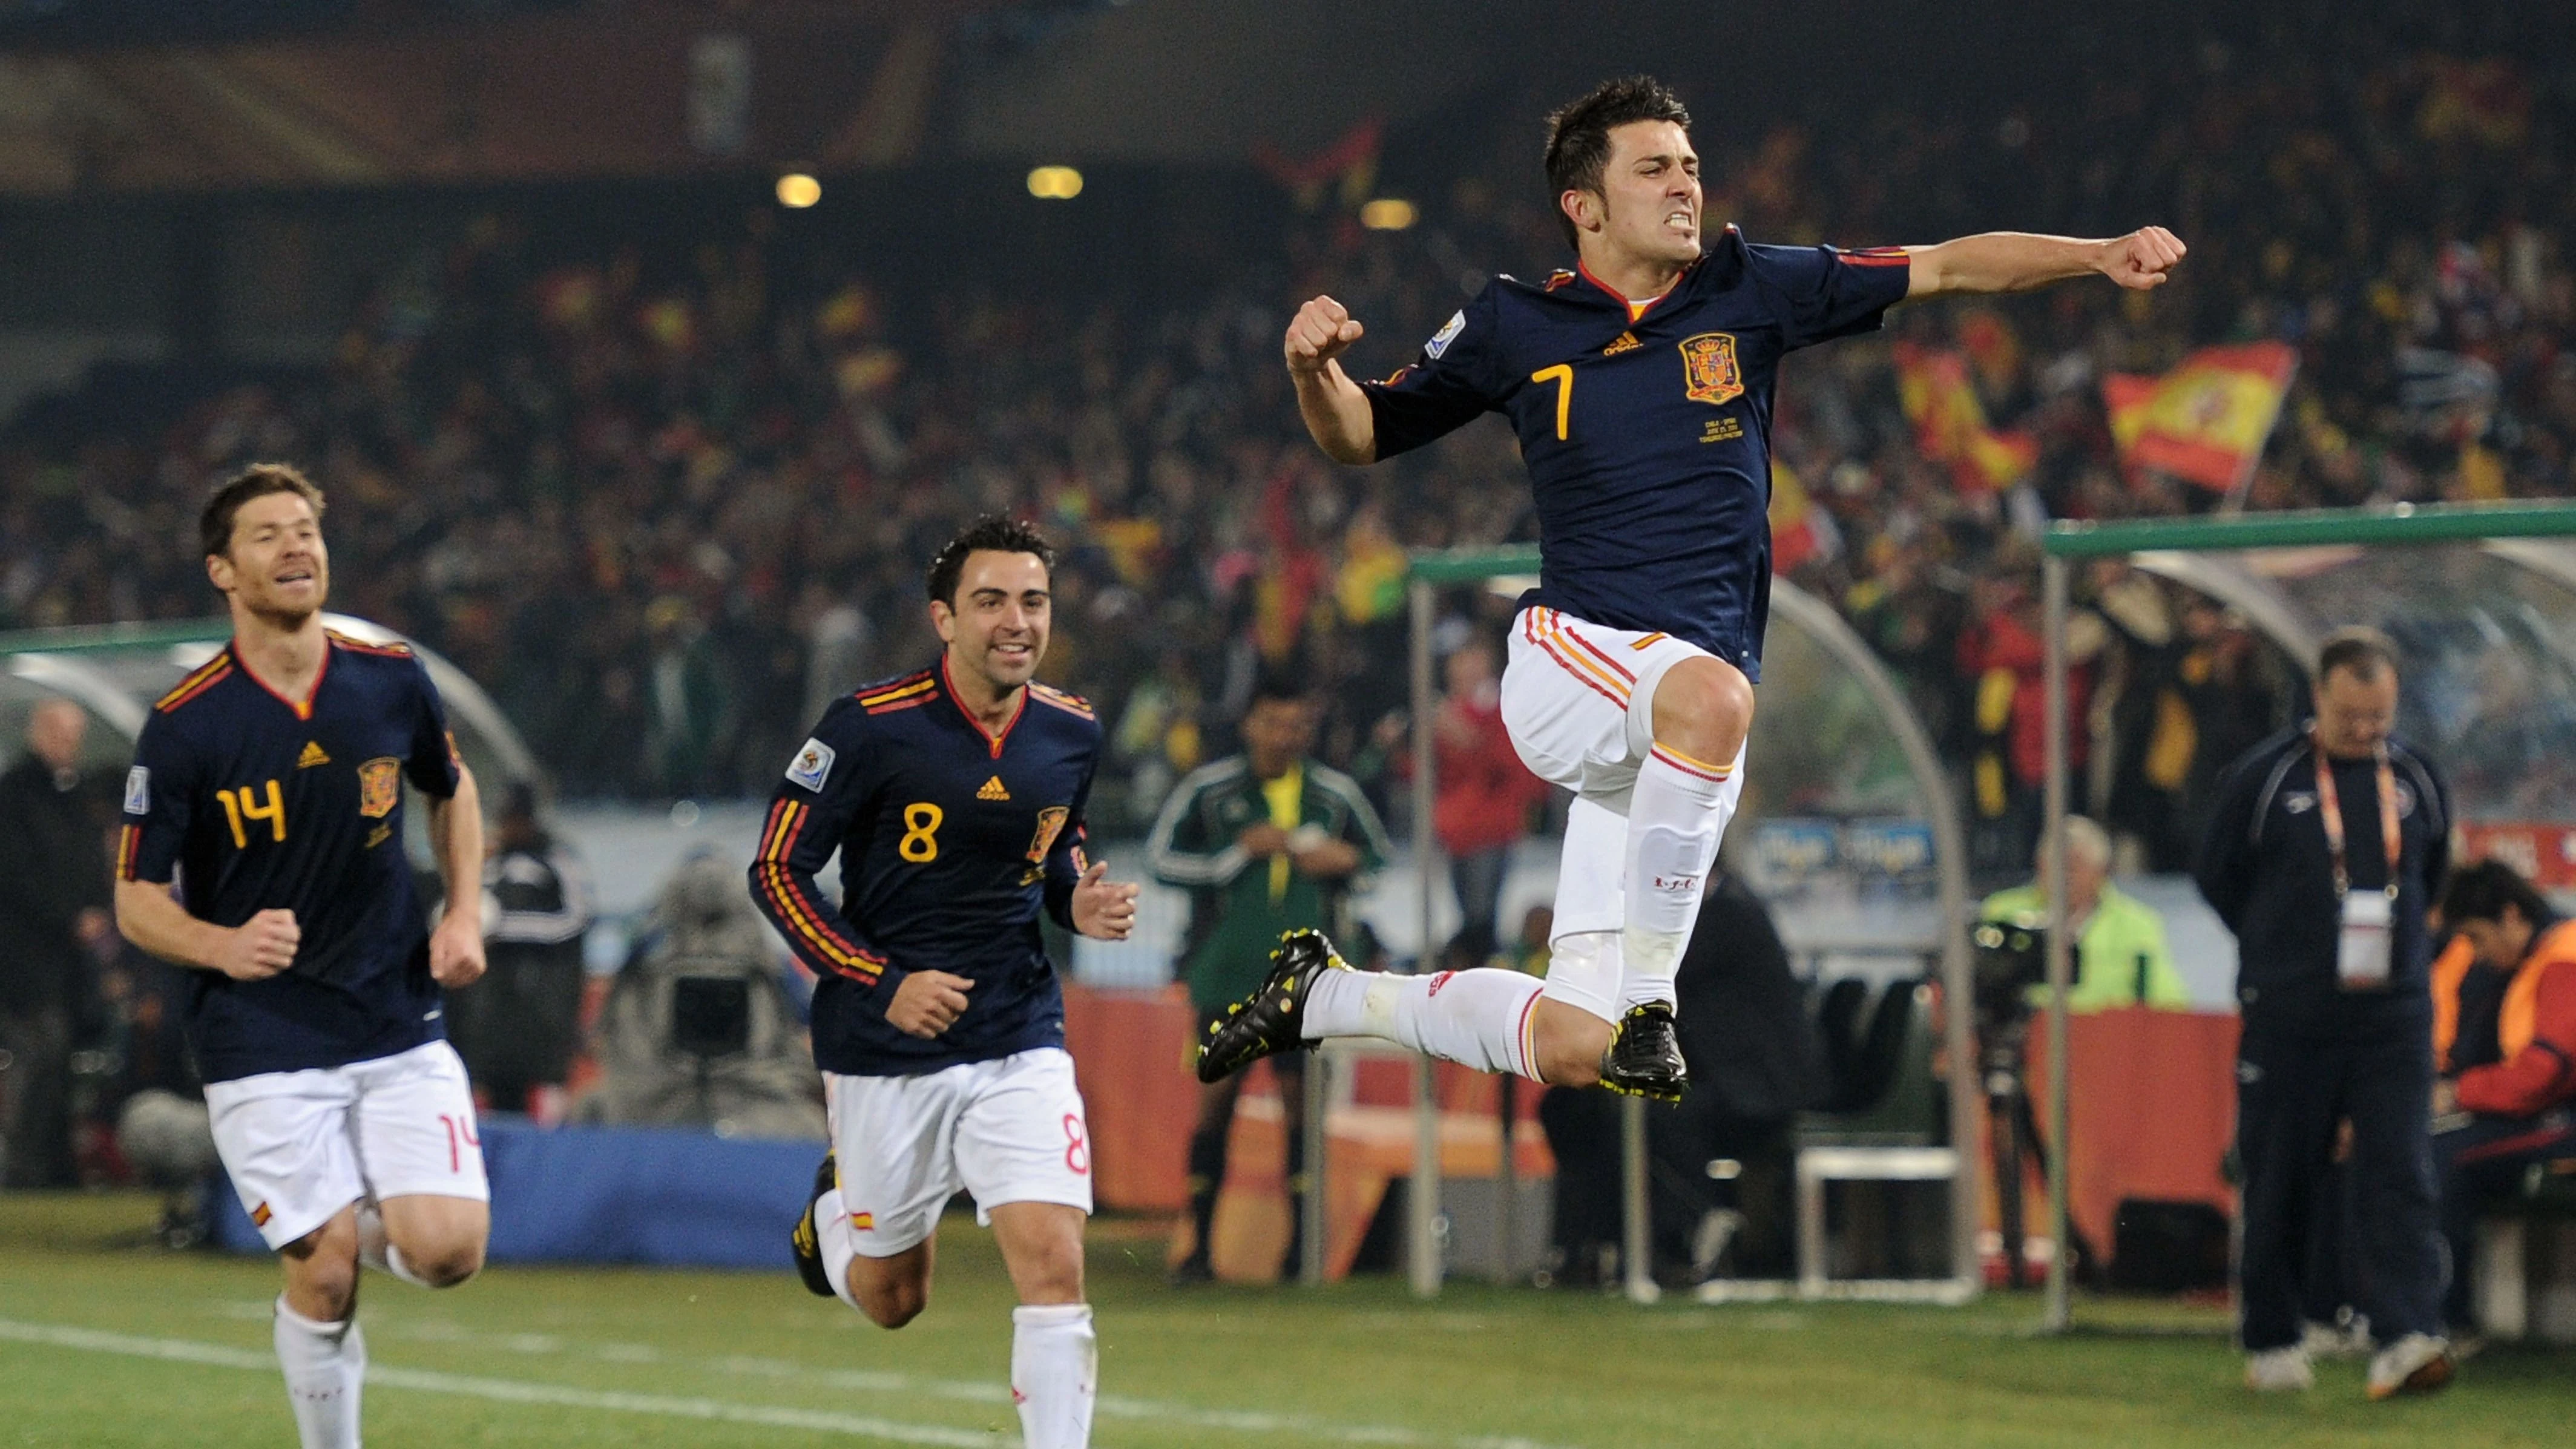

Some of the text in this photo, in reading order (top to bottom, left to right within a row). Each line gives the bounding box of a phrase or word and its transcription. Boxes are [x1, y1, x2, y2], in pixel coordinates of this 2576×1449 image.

[1531, 364, 1574, 441] 7
[215, 779, 286, 849] 14
[899, 802, 944, 862] 8
[1062, 1113, 1088, 1176] 8
